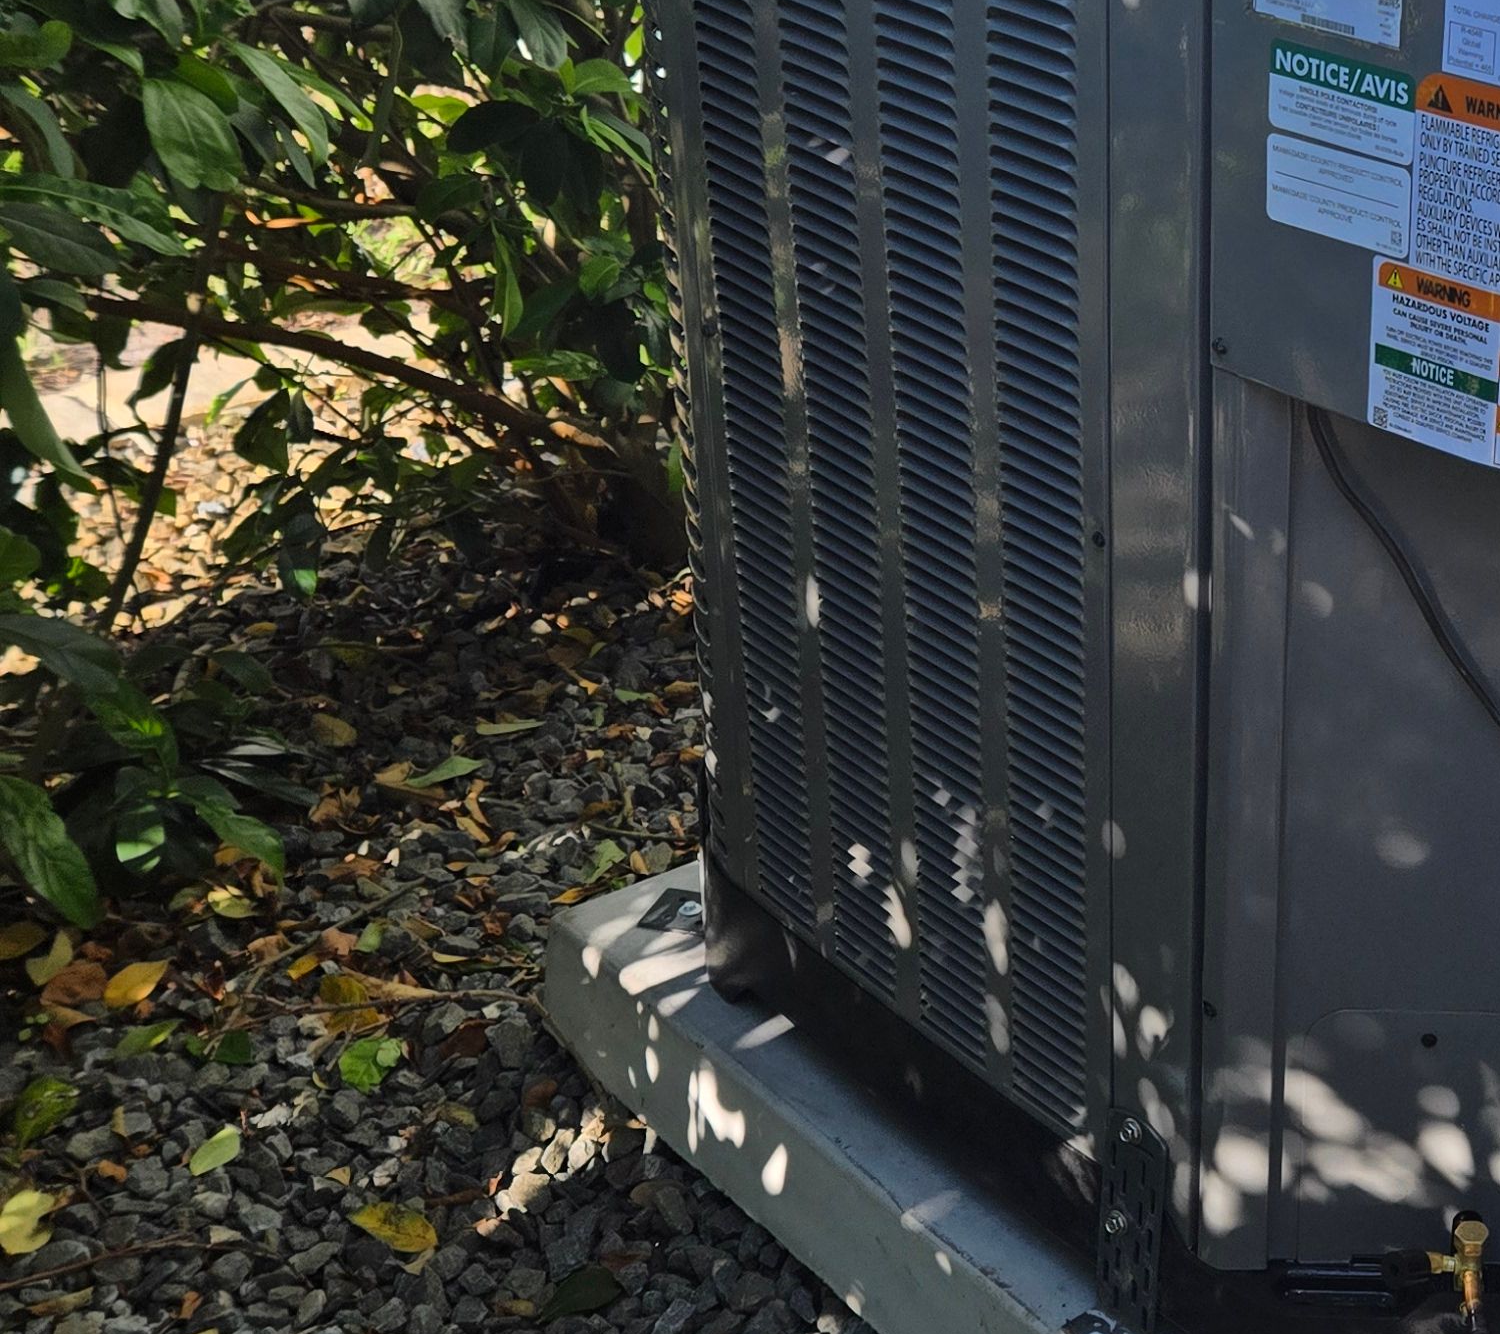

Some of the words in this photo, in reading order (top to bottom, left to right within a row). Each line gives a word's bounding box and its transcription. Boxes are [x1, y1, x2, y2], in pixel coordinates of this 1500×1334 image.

[1275, 48, 1409, 105] NOTICE/AVIS
[1421, 114, 1470, 142] FLAMMABLE
[1420, 131, 1441, 151] ONLY
[1443, 137, 1453, 154] BY
[1454, 140, 1489, 165] TRAINED
[1420, 151, 1461, 178] PUNCTURE
[1419, 168, 1458, 191] PROPERLY
[1459, 180, 1468, 196] IN
[1418, 183, 1474, 214] REGULATIONS.
[1416, 217, 1426, 231] ES
[1427, 221, 1452, 240] SHALL
[1453, 229, 1471, 244] NOT
[1472, 234, 1482, 249] BE
[1417, 201, 1459, 226] AUXILIARY
[1459, 214, 1493, 236] DEVICES
[1415, 233, 1442, 253] OTHER
[1443, 240, 1466, 260] THAN
[1415, 250, 1436, 268] WITH
[1437, 256, 1452, 275] THE
[1453, 261, 1488, 285] SPECIFIC
[1416, 276, 1471, 308] WARNING
[1392, 293, 1448, 319] HAZARDOUS
[1449, 311, 1490, 333] VOLTAGE
[1393, 308, 1407, 318] CAN
[1408, 313, 1428, 325] CAUSE
[1411, 357, 1455, 387] NOTICE
